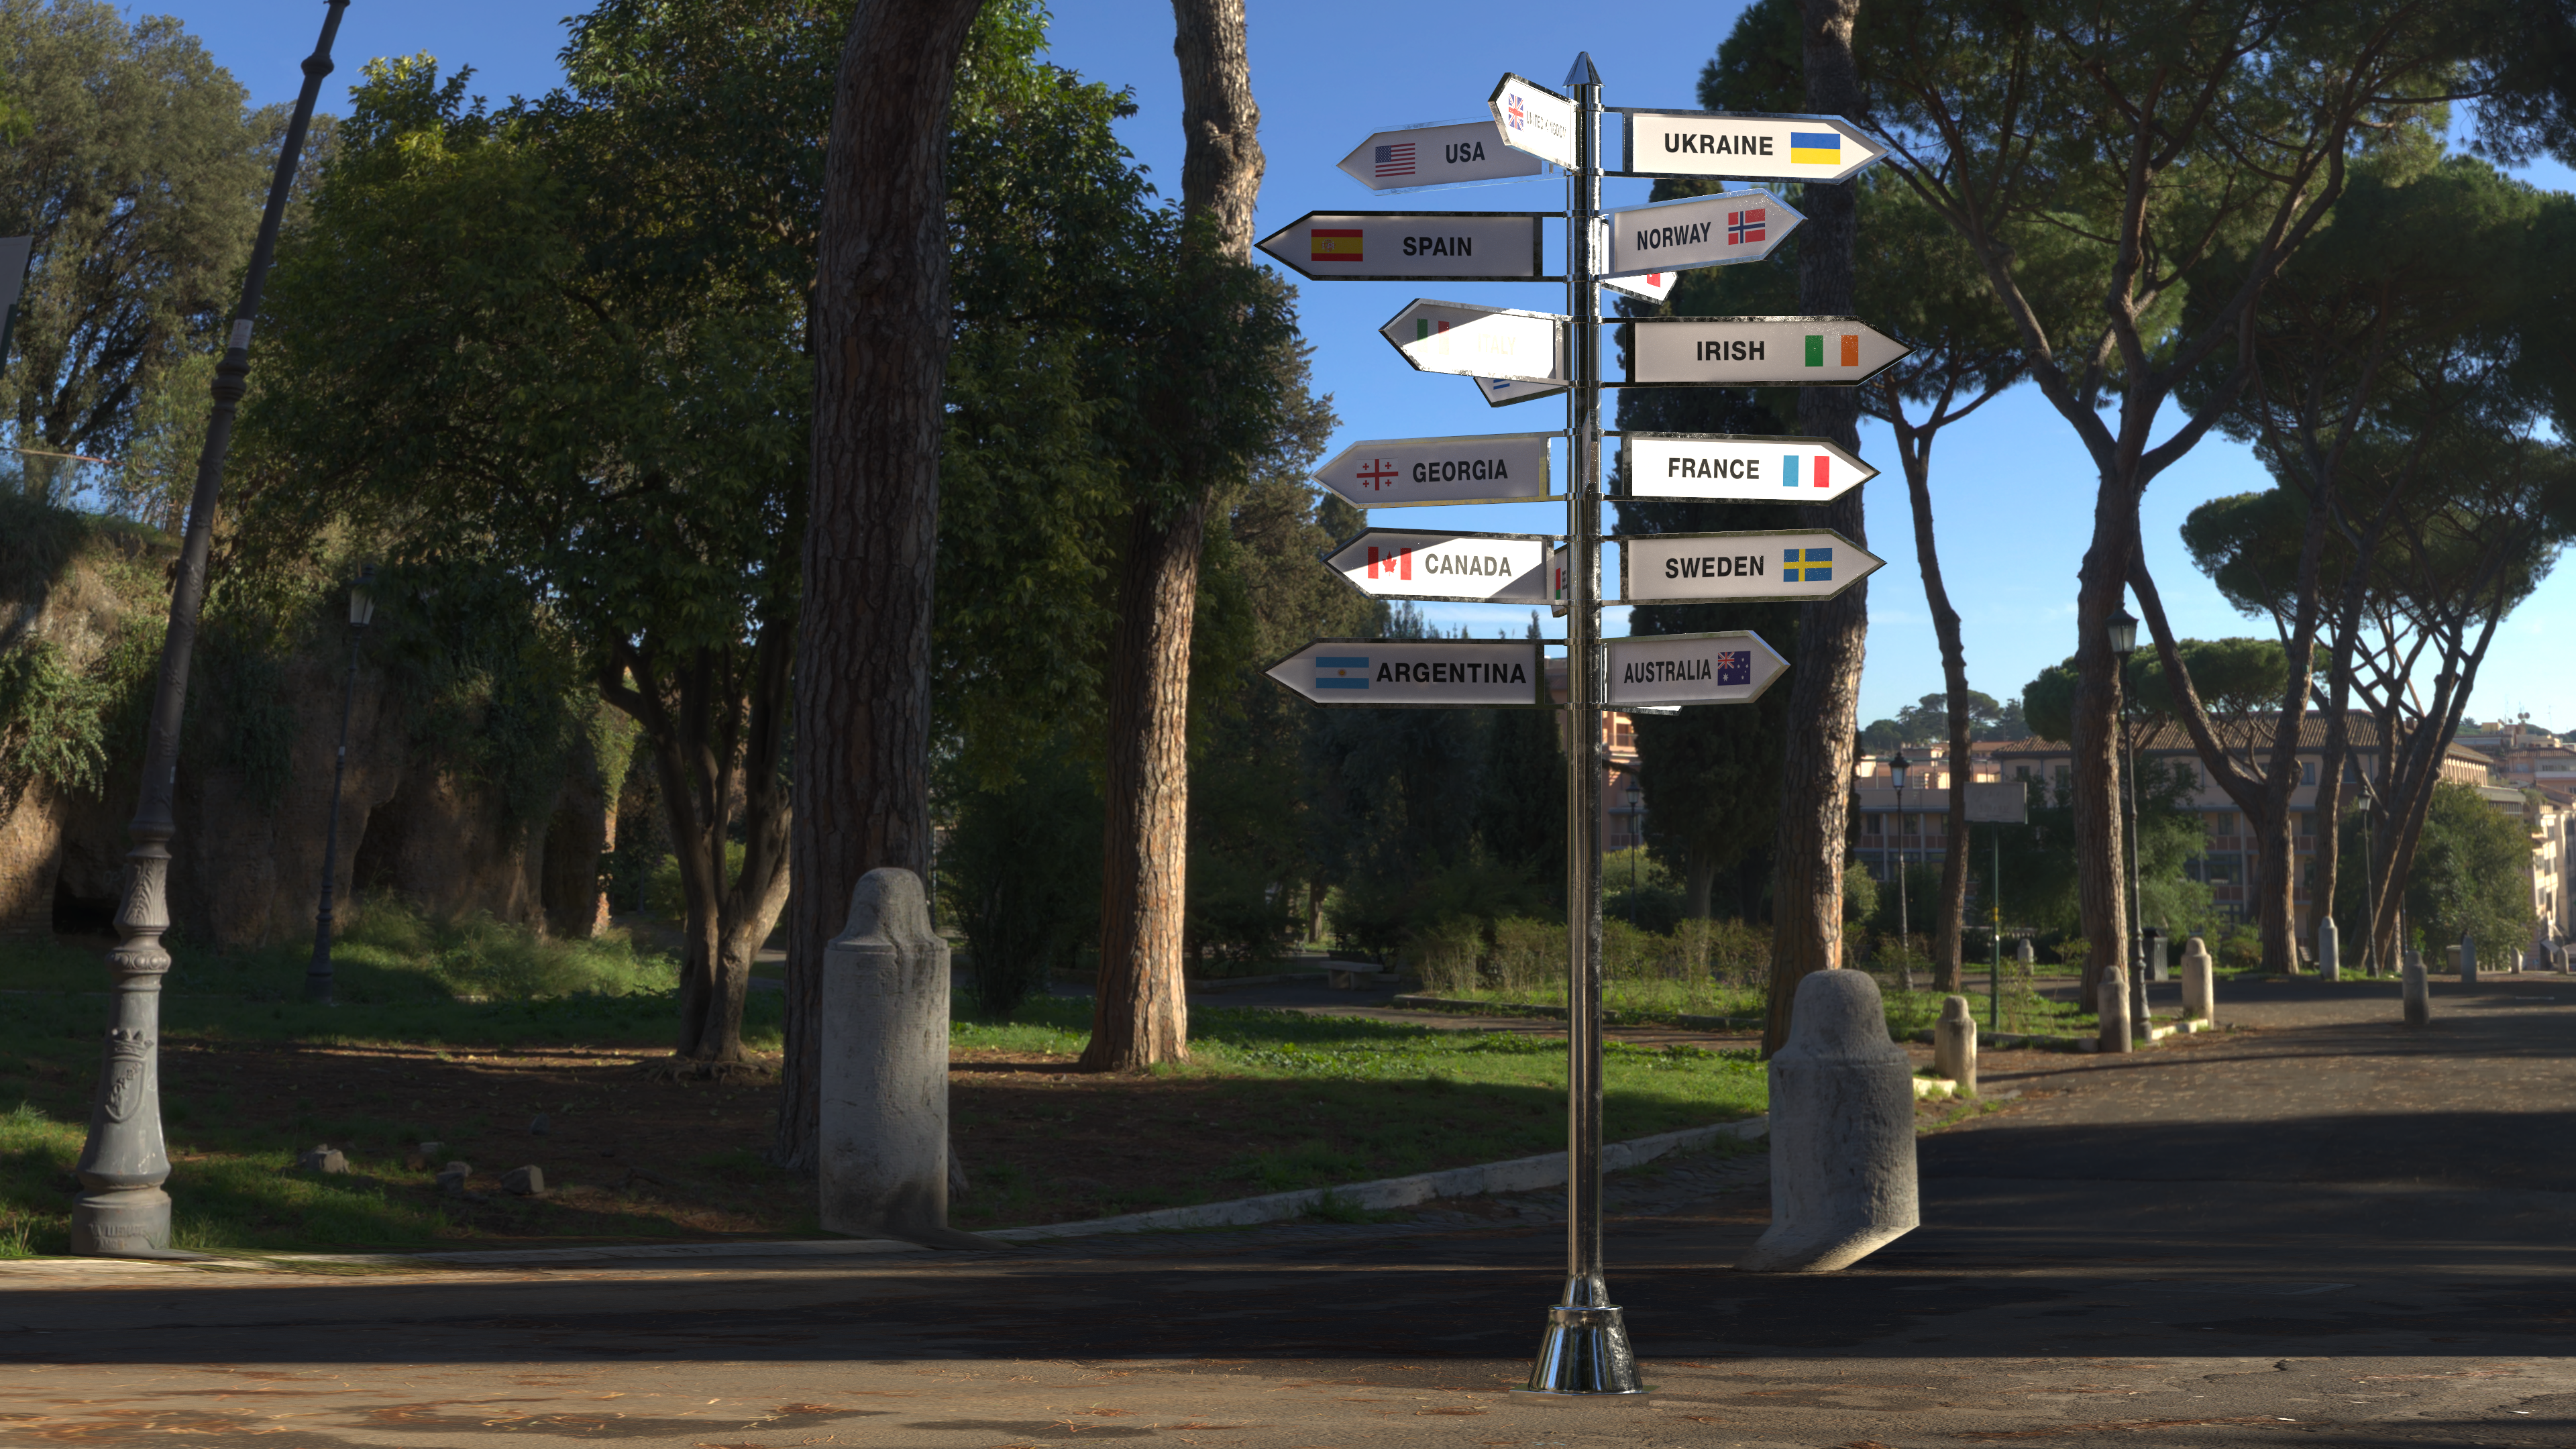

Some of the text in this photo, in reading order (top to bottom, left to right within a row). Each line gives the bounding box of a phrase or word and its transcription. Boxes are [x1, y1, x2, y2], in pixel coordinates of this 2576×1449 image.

[1446, 142, 1485, 164] USA
[1664, 133, 1773, 156] UKRAINE
[1403, 236, 1472, 256] SPAIN
[1637, 221, 1711, 251] NORWAY
[1478, 333, 1517, 356] ITALY
[1697, 341, 1765, 361] IRISH
[1412, 459, 1509, 483] GEORGIA
[1668, 458, 1760, 480] FRANCE
[1425, 553, 1512, 577] CANADA
[1665, 555, 1764, 579] SWEDEN
[1376, 662, 1527, 683] ARGENTINA
[1623, 659, 1712, 684] AUSTRALIA
